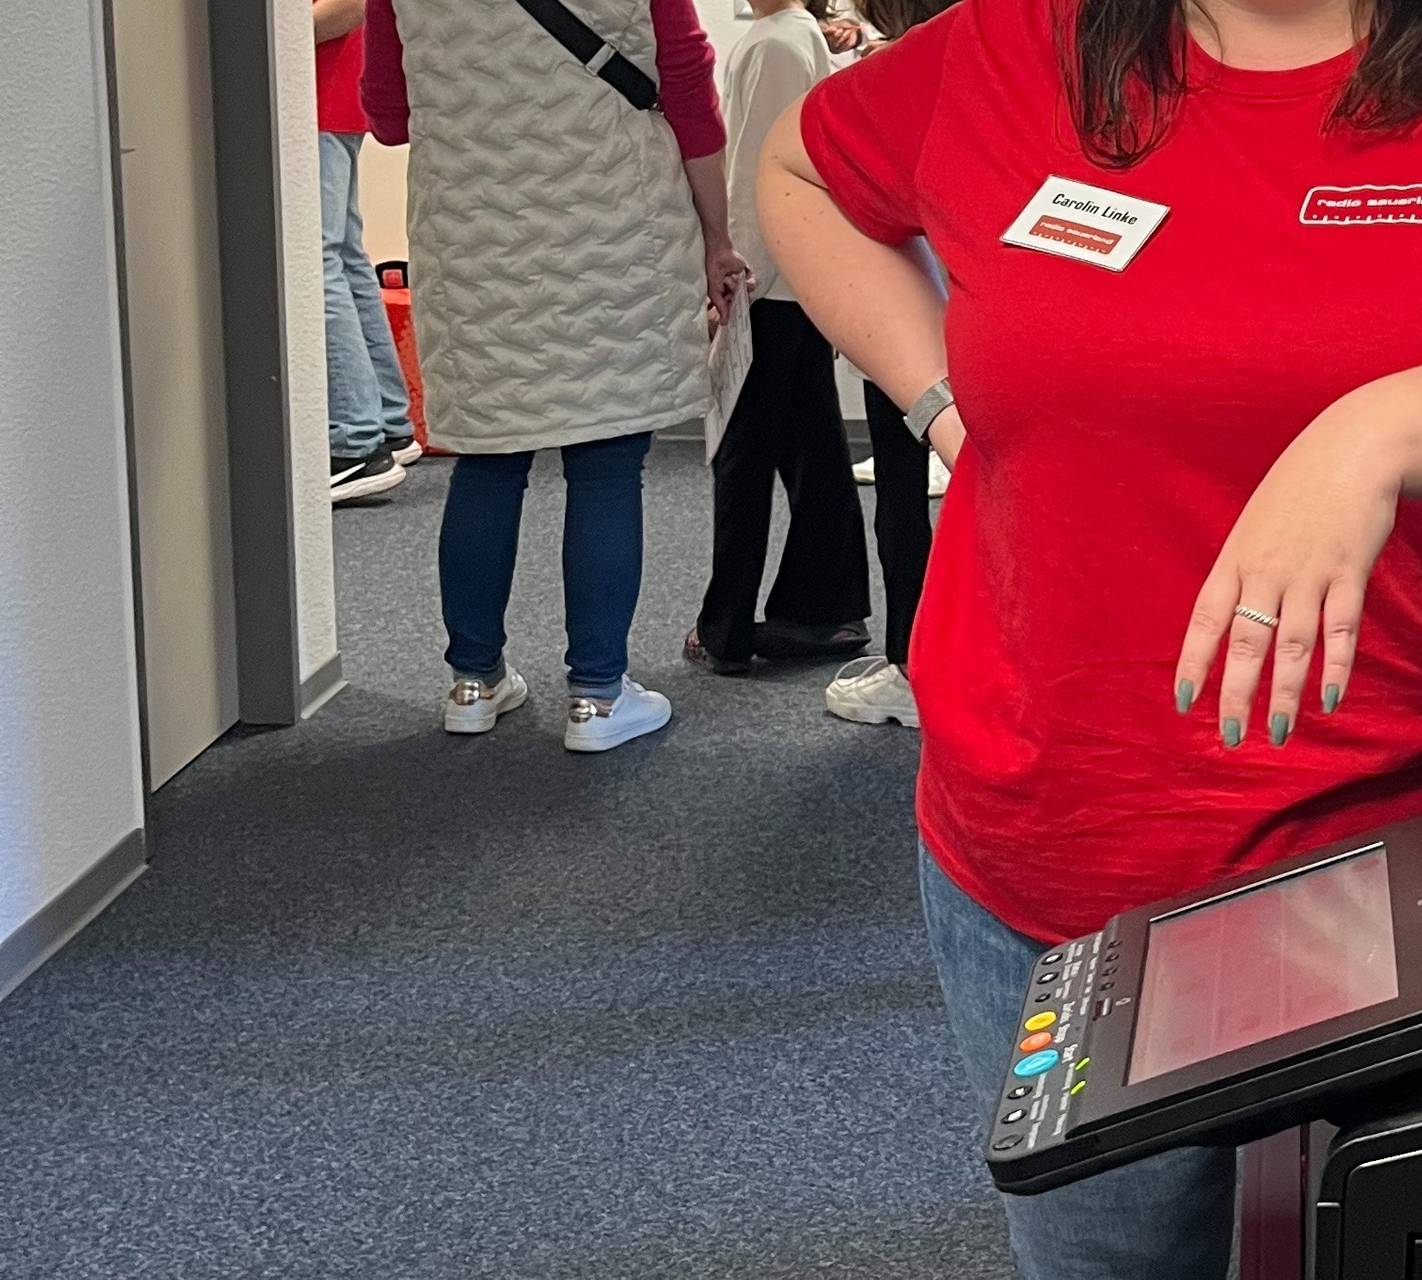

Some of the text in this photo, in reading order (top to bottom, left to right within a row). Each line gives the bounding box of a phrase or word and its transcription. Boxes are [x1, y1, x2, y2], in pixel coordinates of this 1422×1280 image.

[1052, 193, 1138, 225] Carolin Linke
[1317, 198, 1361, 208] radio
